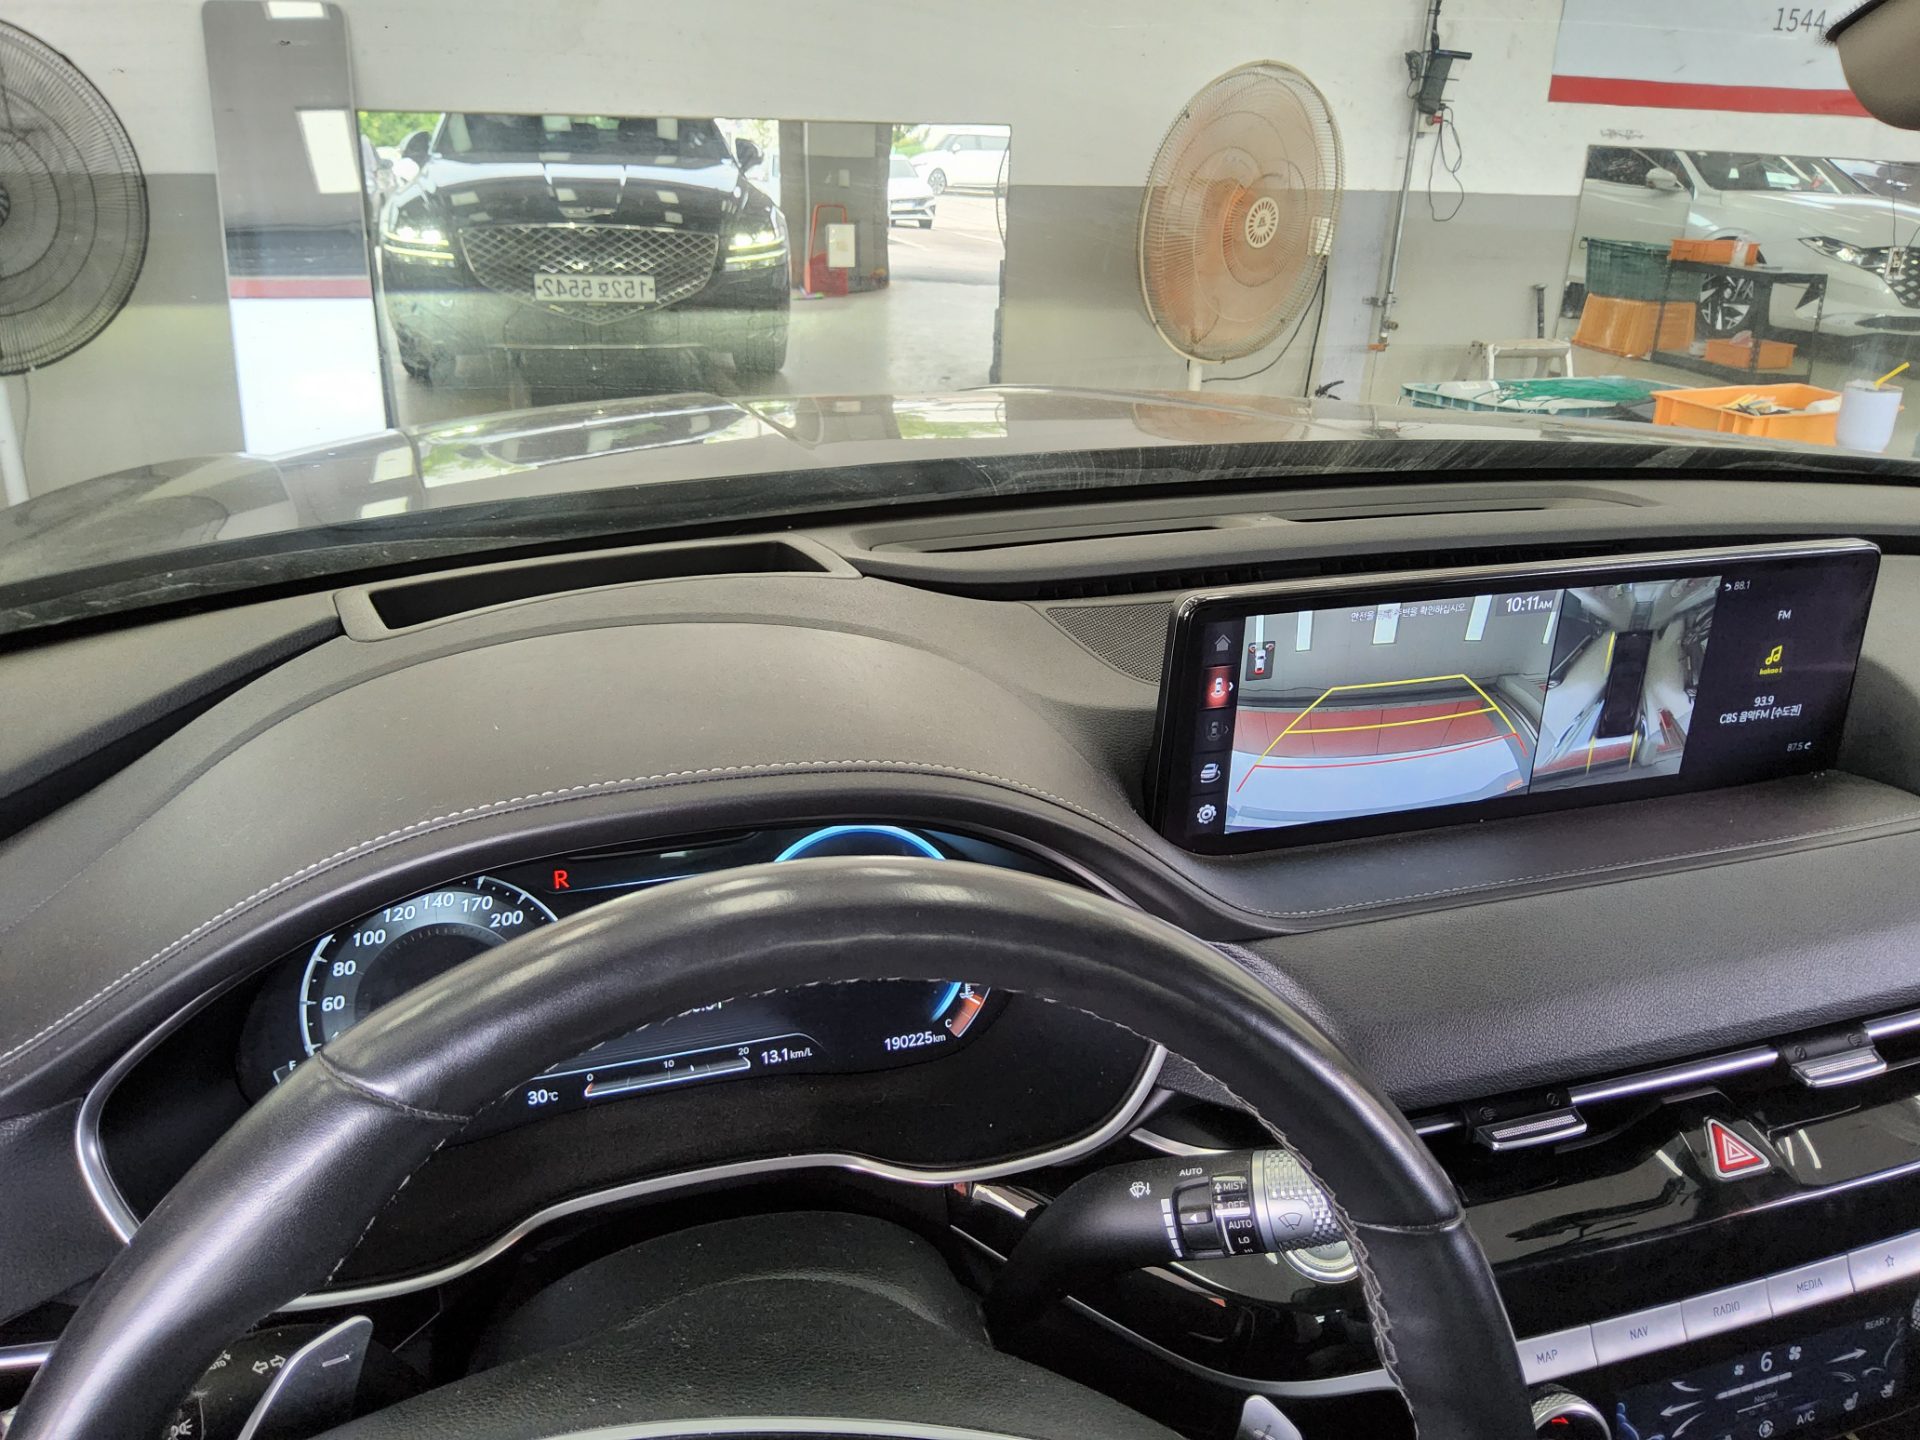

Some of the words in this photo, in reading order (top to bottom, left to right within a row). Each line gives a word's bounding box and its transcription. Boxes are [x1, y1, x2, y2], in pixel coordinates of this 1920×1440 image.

[1773, 7, 1826, 34] 1544
[1733, 581, 1750, 591] 88.1
[1420, 603, 1467, 617] 확인하십시오
[1777, 609, 1791, 621] FM
[1754, 695, 1774, 707] 93.9
[1719, 712, 1738, 724] CBS
[1786, 742, 1803, 752] 87.5
[553, 869, 570, 889] R
[422, 892, 454, 910] 140
[461, 896, 493, 912] 170
[383, 905, 415, 923] 120
[490, 910, 524, 928] 200
[353, 929, 386, 947] 100
[332, 960, 356, 977] 80
[321, 995, 345, 1012] 60
[945, 1018, 952, 1028] C
[738, 1047, 750, 1056] 20
[288, 1060, 296, 1071] F
[663, 1059, 675, 1069] 10
[586, 1073, 594, 1082] 0
[1179, 1167, 1203, 1177] AUTO
[1223, 1181, 1245, 1192] MIST
[1228, 1219, 1253, 1230] AUTO
[1238, 1236, 1250, 1244] LO
[1796, 1277, 1824, 1293] MEDIA
[1713, 1301, 1741, 1317] RADIO
[1864, 1317, 1886, 1330] REAR
[1629, 1325, 1649, 1341] NAV
[1536, 1349, 1558, 1365] MAP
[1760, 1351, 1773, 1373] 6
[1796, 1410, 1815, 1426] A/C
